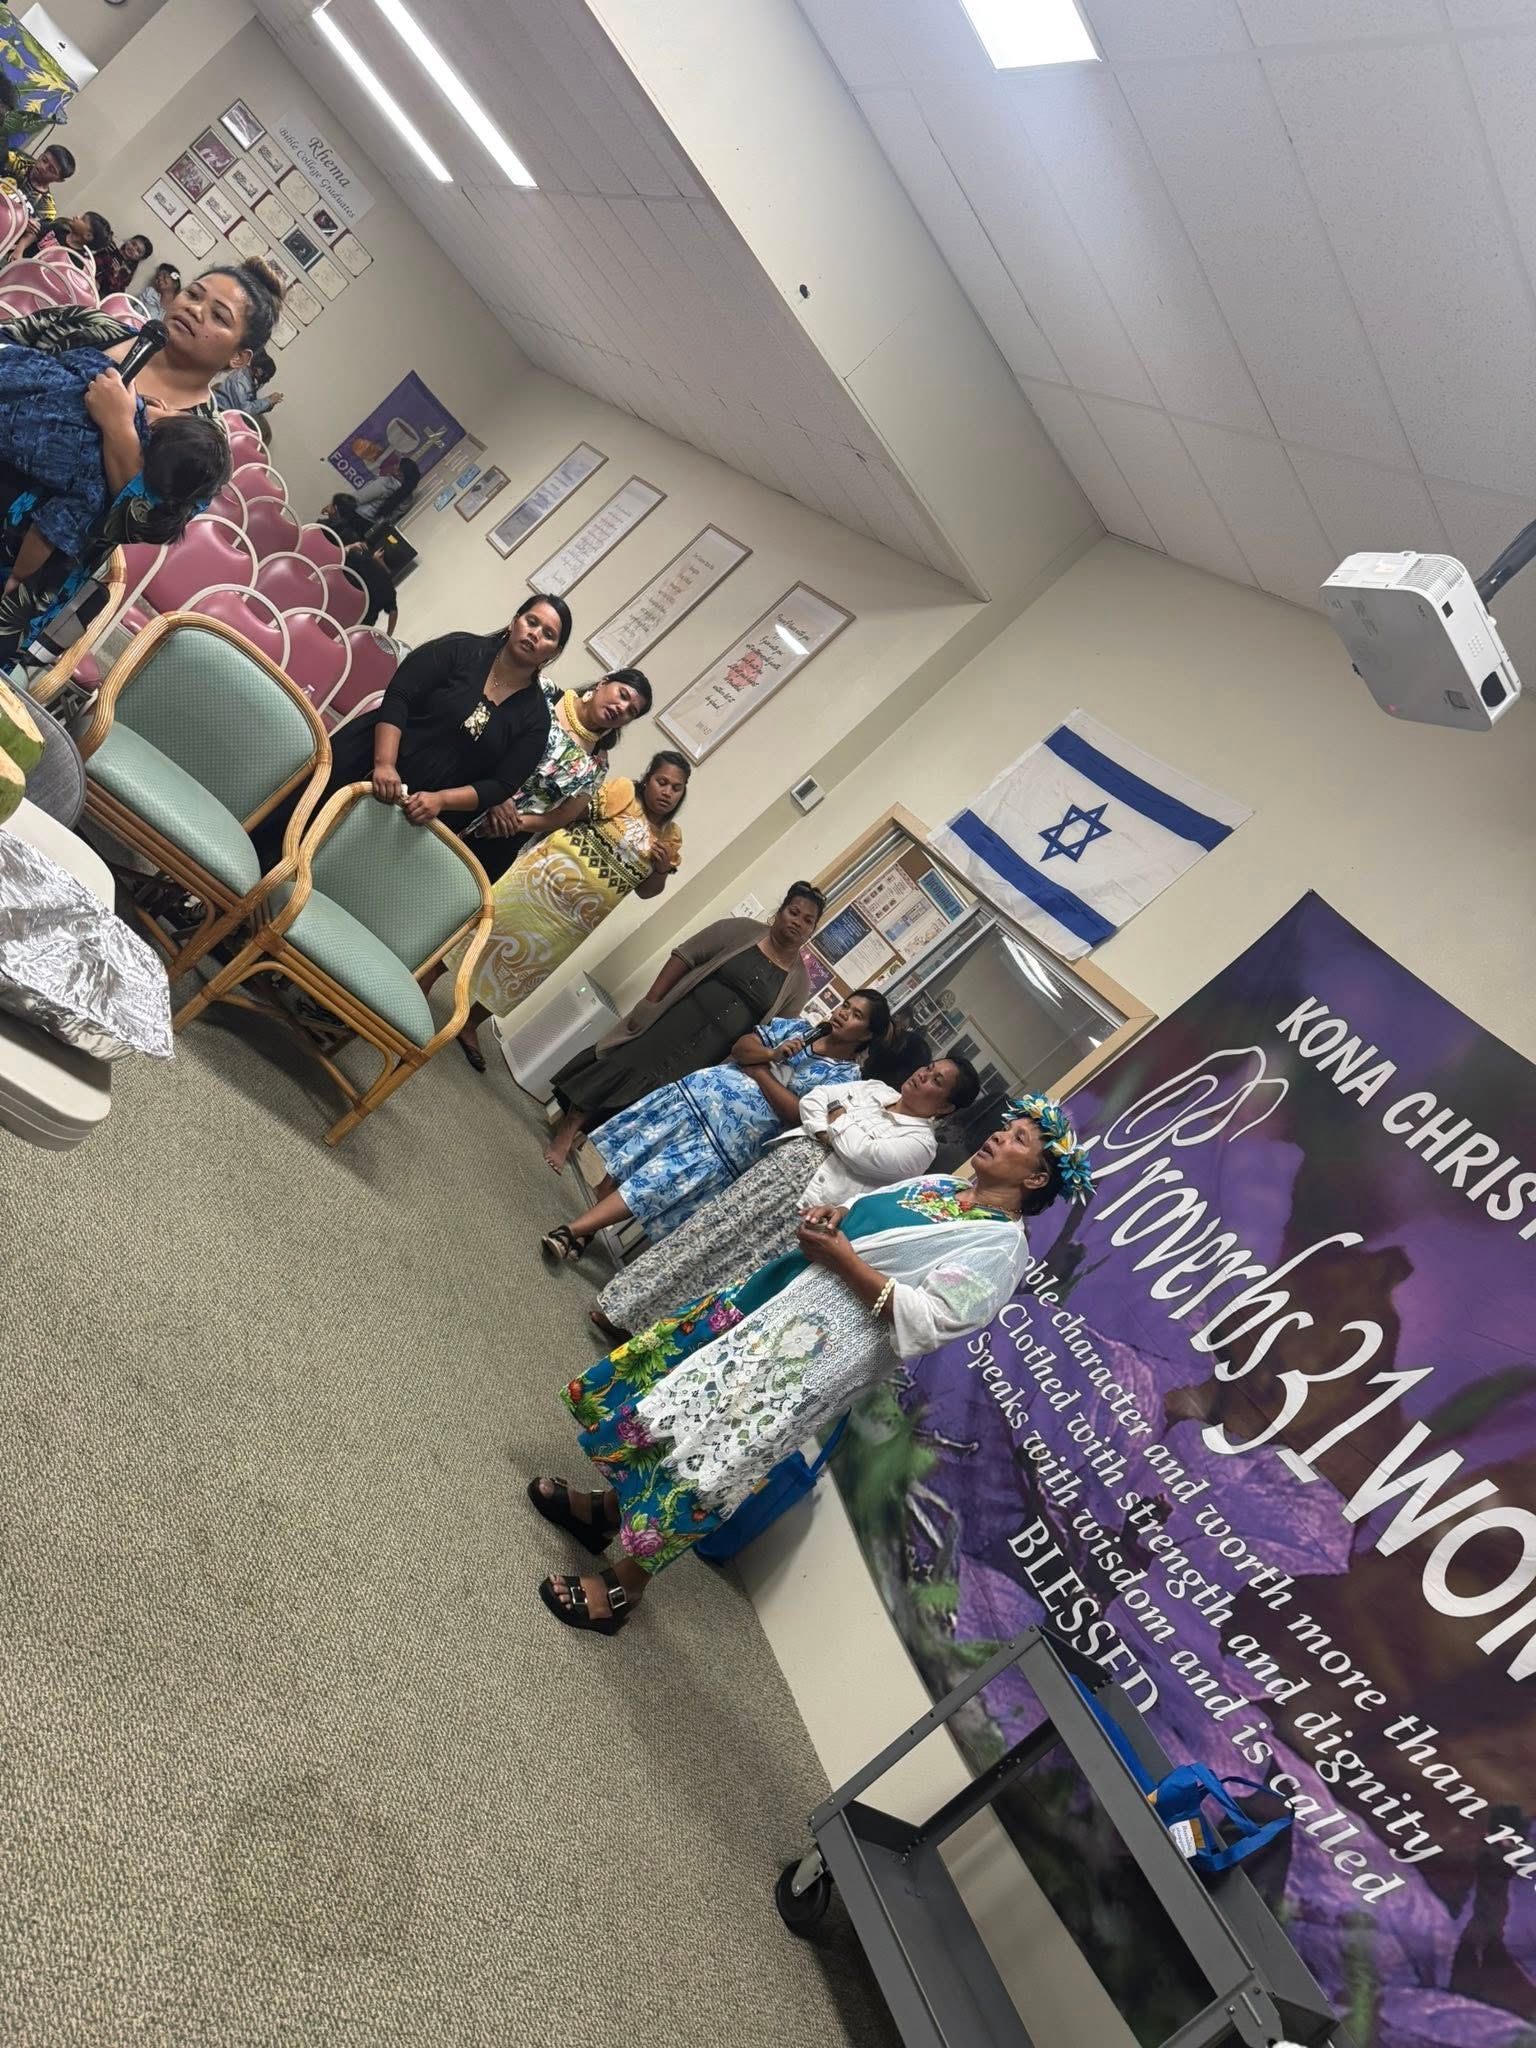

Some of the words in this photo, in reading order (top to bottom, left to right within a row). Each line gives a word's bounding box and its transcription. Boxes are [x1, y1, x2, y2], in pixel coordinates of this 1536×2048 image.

[279, 126, 299, 151] Bible
[296, 148, 322, 179] College
[320, 176, 356, 219] Graduates
[308, 135, 351, 189] Rhema
[1276, 995, 1398, 1107] KONA
[1083, 1045, 1365, 1382] Proverbs
[1201, 1320, 1436, 1484] 31
[966, 1331, 1030, 1430] Speaks
[1022, 1429, 1084, 1508] with
[1072, 1508, 1176, 1645] wisdom
[1169, 1650, 1250, 1722] and
[1231, 1721, 1275, 1765] is
[1270, 1772, 1406, 1905] called
[998, 1303, 1082, 1413] Clothed
[1066, 1411, 1128, 1488] with
[1116, 1491, 1236, 1628] strength
[1227, 1634, 1312, 1706] and
[1293, 1711, 1444, 1864] dignity
[1007, 1515, 1160, 1715] BLESSED
[1051, 1311, 1153, 1438] character
[1142, 1444, 1211, 1504] and
[1195, 1503, 1295, 1611] worth
[1287, 1613, 1387, 1712] more
[1383, 1715, 1489, 1820] than
[1484, 1824, 1536, 1892] ru
